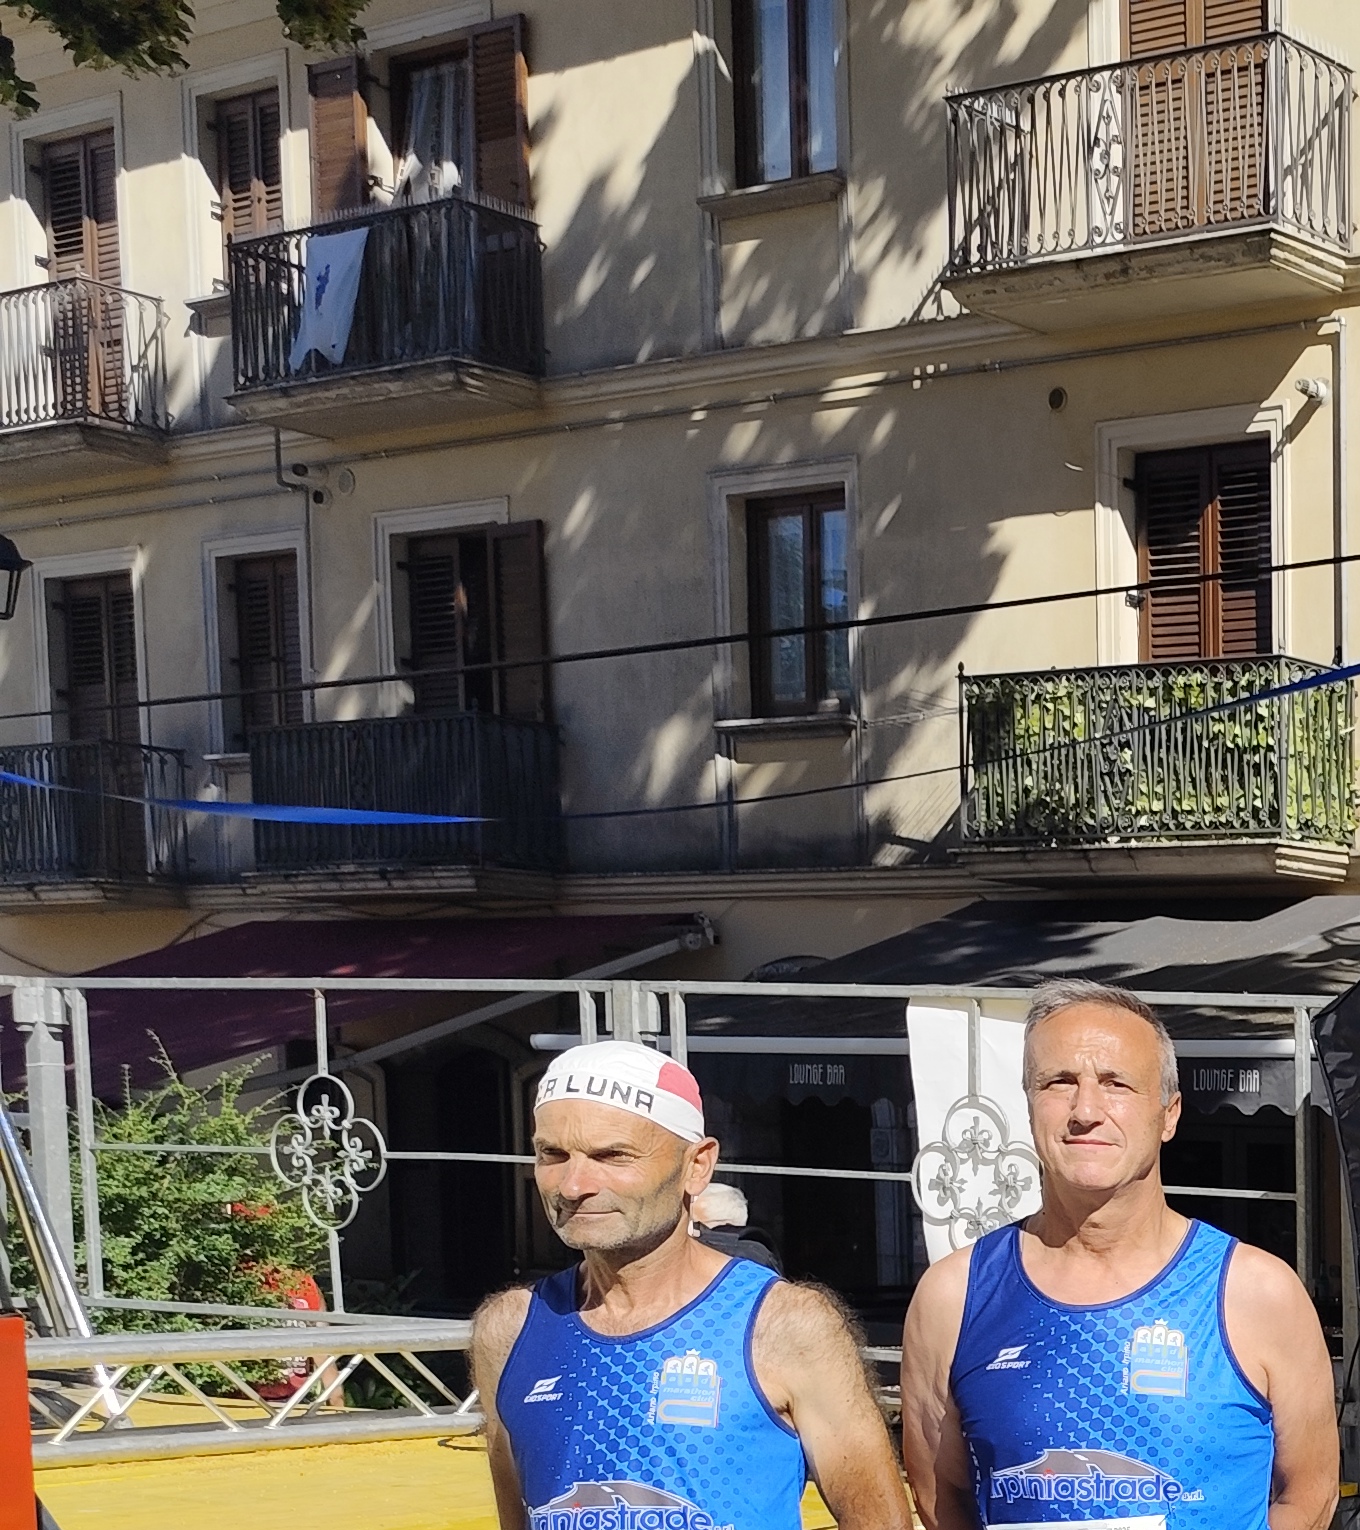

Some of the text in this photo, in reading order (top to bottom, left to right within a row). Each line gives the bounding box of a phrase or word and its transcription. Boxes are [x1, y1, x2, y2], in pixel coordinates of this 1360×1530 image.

[789, 1064, 846, 1086] LOUNGE BAR
[1193, 1068, 1261, 1093] LOUNGE BAR
[565, 1074, 656, 1114] LUNA
